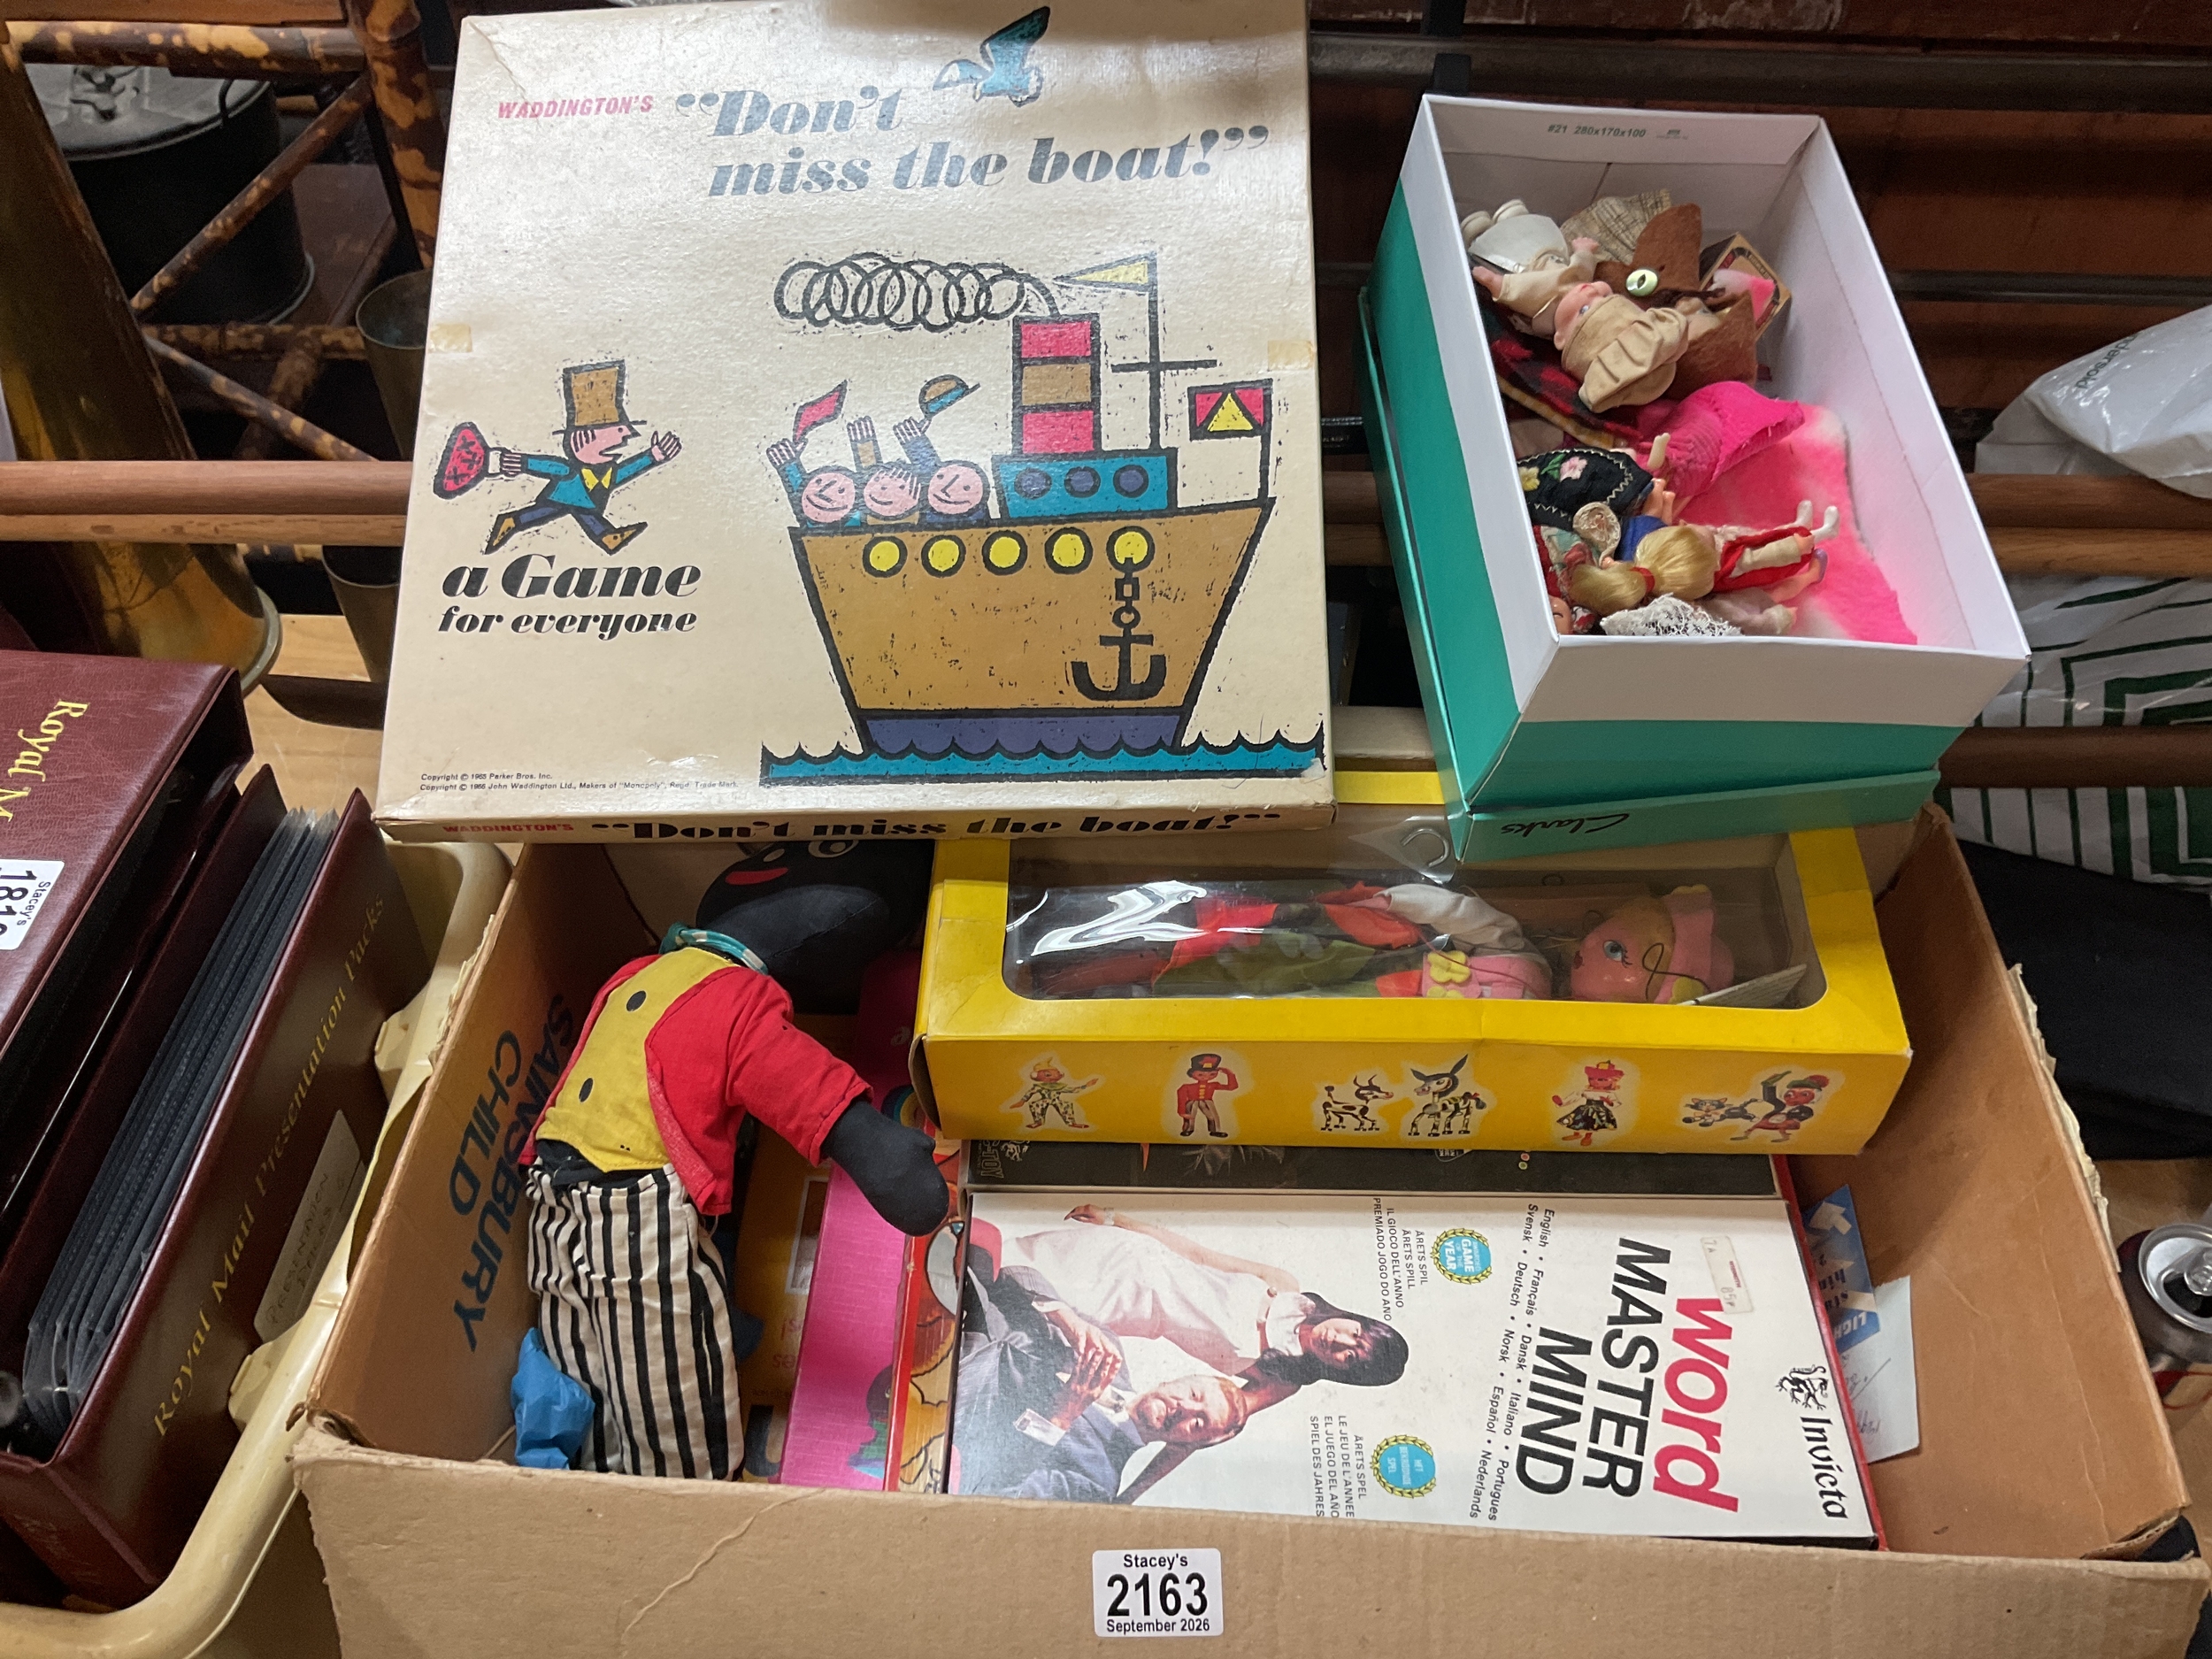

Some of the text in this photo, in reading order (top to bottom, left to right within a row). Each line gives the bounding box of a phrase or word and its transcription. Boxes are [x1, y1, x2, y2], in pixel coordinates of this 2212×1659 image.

[497, 95, 654, 119] WADDINGTON'S
[708, 146, 872, 196] miss
[893, 141, 1008, 190] the
[442, 553, 702, 598] a Game
[438, 605, 697, 641] for everyone
[8, 699, 90, 782] Royal
[511, 782, 557, 791] Waddington
[442, 823, 574, 833] WADDINGTON'S
[811, 818, 947, 837] miss
[966, 817, 1063, 834] the
[1501, 812, 1630, 838] Clarks
[17, 880, 51, 926] Stacey's
[449, 1030, 522, 1216] CHILD
[152, 894, 384, 1437] Royal Mail Presentation Packs
[453, 994, 574, 1352] SAINSBURY
[1373, 1197, 1392, 1322] PREMIADO JOGO DO ANO
[1386, 1208, 1404, 1308] IL GIOCO DELL'ANNO
[1402, 1229, 1416, 1289] ÅRETS SPILL
[1415, 1230, 1428, 1285] ÅRETS SPIL
[1444, 1240, 1457, 1271] YEAR
[1455, 1242, 1462, 1251] OF
[1461, 1239, 1475, 1273] GAME
[1470, 1203, 1539, 1519] Svensk Deutsch Norsk Español Nederlands
[1488, 1208, 1555, 1521] English Français Dansk Italiano Portugues
[1582, 1237, 1671, 1498] MASTER
[1338, 1416, 1348, 1427] LE
[1515, 1326, 1594, 1496] MIND
[1339, 1429, 1349, 1451] JEU
[1341, 1453, 1351, 1468] DE
[1310, 1416, 1325, 1517] SPIEL DES JAHRES
[1324, 1416, 1340, 1518] EL JUEGO DEL AÑO
[1354, 1434, 1367, 1500] ÅRETS SPEL
[1387, 1456, 1397, 1473] SPEL
[1800, 1416, 1849, 1519] Invicta
[1123, 1553, 1188, 1571] Stacey's
[1107, 1572, 1208, 1617] 2163
[1107, 1618, 1210, 1635] September 2026
